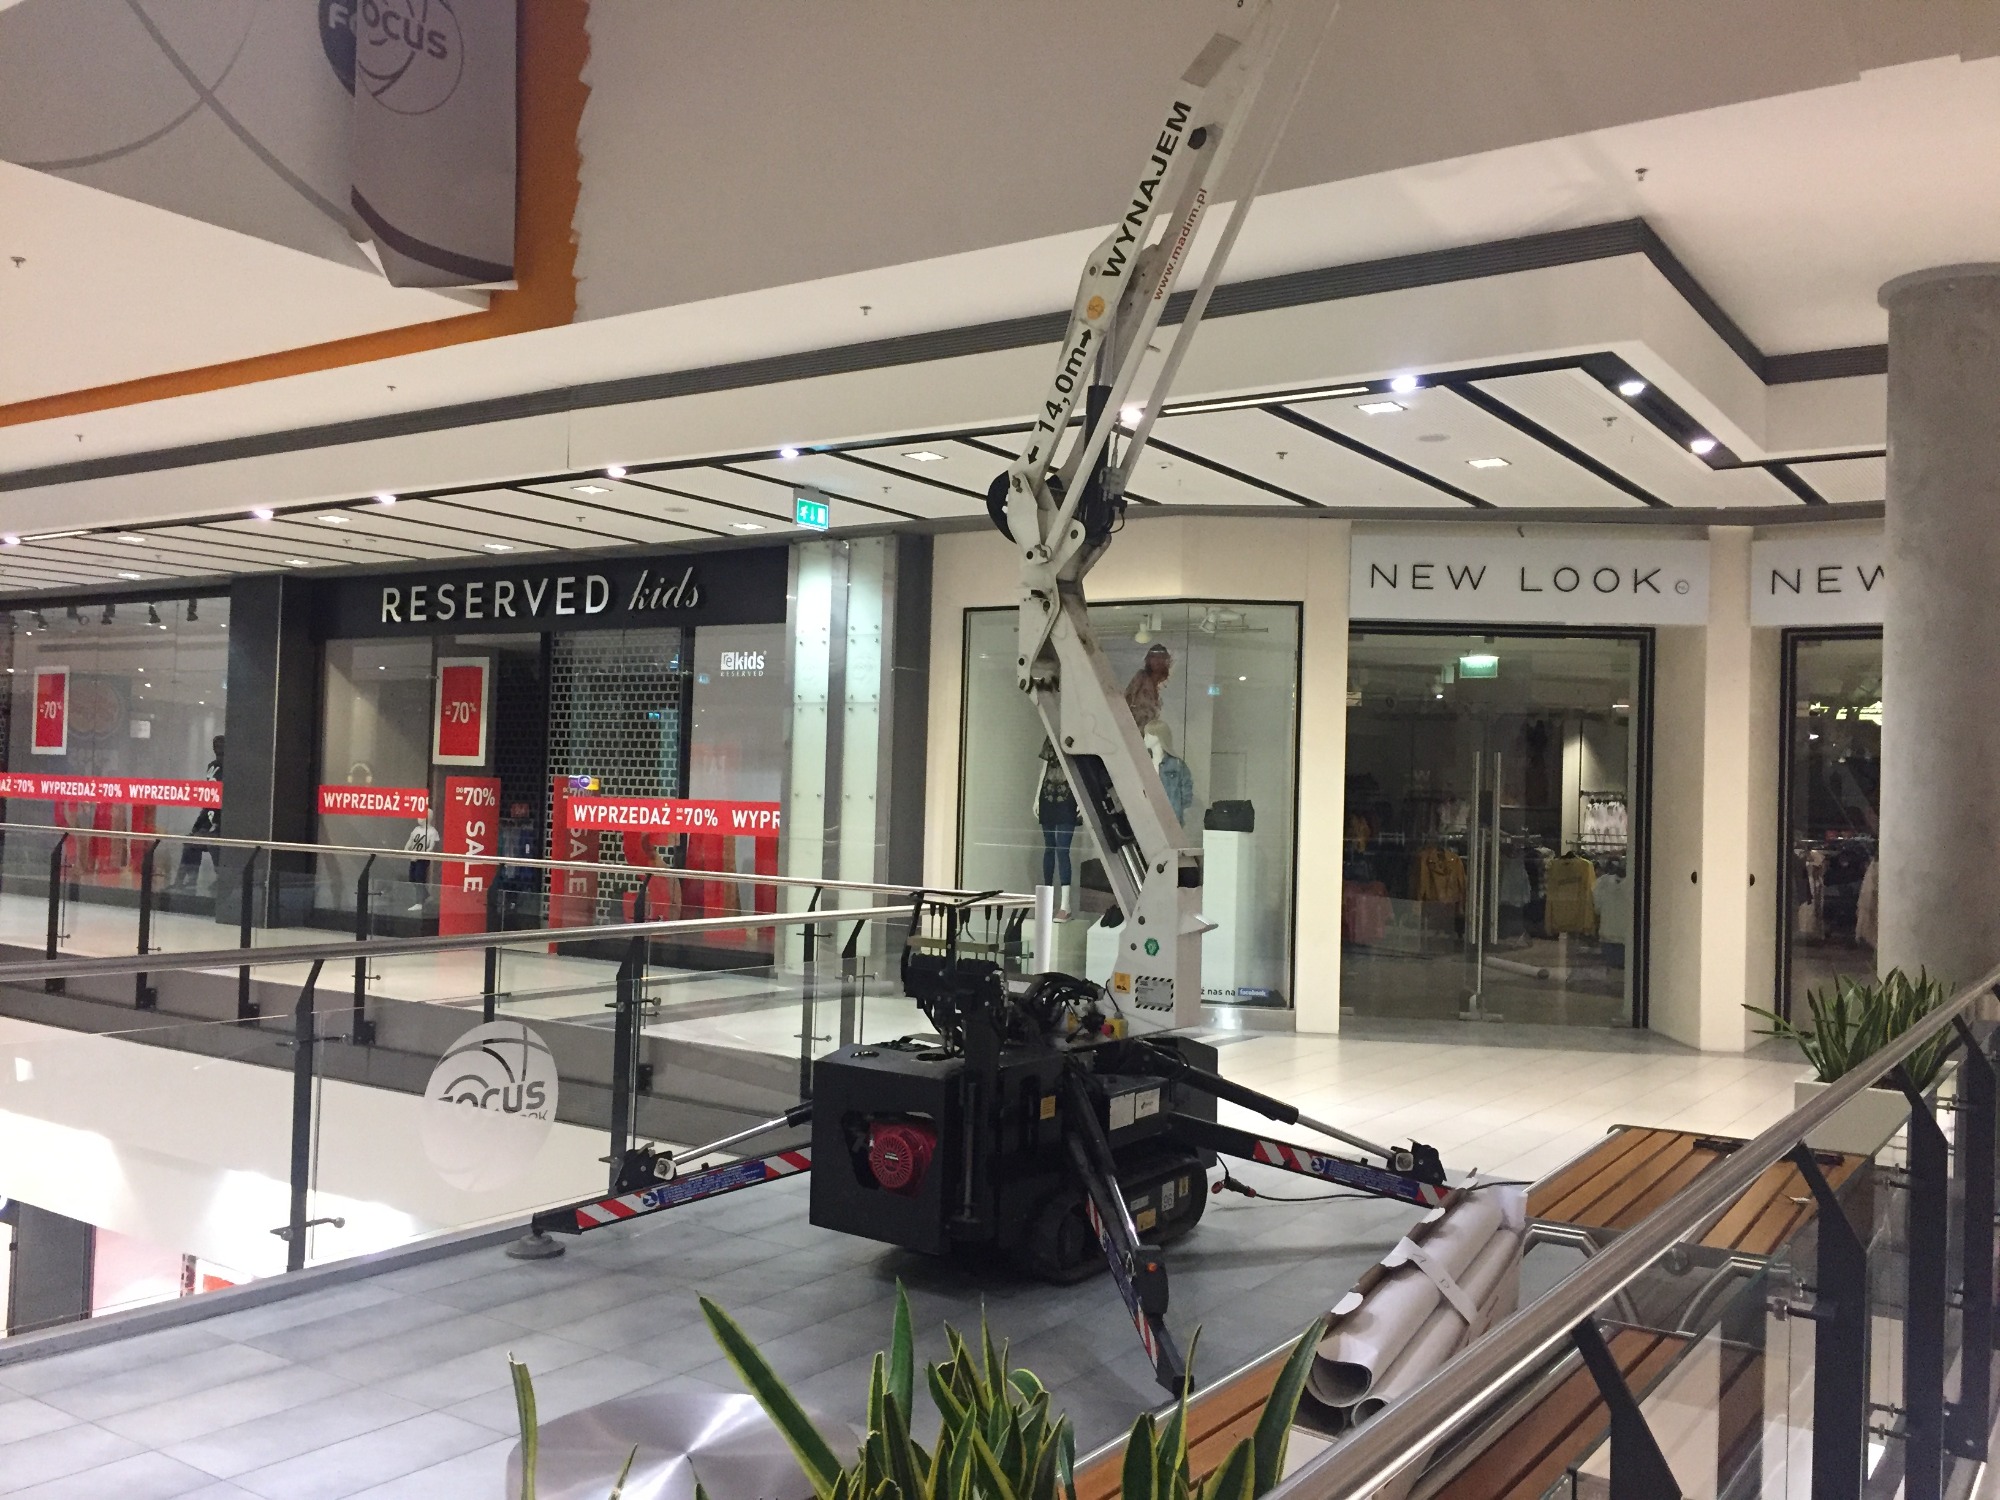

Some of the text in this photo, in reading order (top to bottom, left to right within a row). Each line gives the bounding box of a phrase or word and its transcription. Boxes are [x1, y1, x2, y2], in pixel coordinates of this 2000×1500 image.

[1102, 101, 1192, 277] WYNAJEM
[1154, 187, 1208, 300] www.madim.pl
[1370, 563, 1662, 594] NEW LOOK
[381, 566, 699, 623] RESERVED kids
[41, 780, 96, 797] WYPRZEDAŻ
[129, 783, 190, 801] WYPRZEDAŻ
[323, 792, 400, 811] WYPRZEDAŻ
[573, 803, 671, 825] WYPRZEDAŻ
